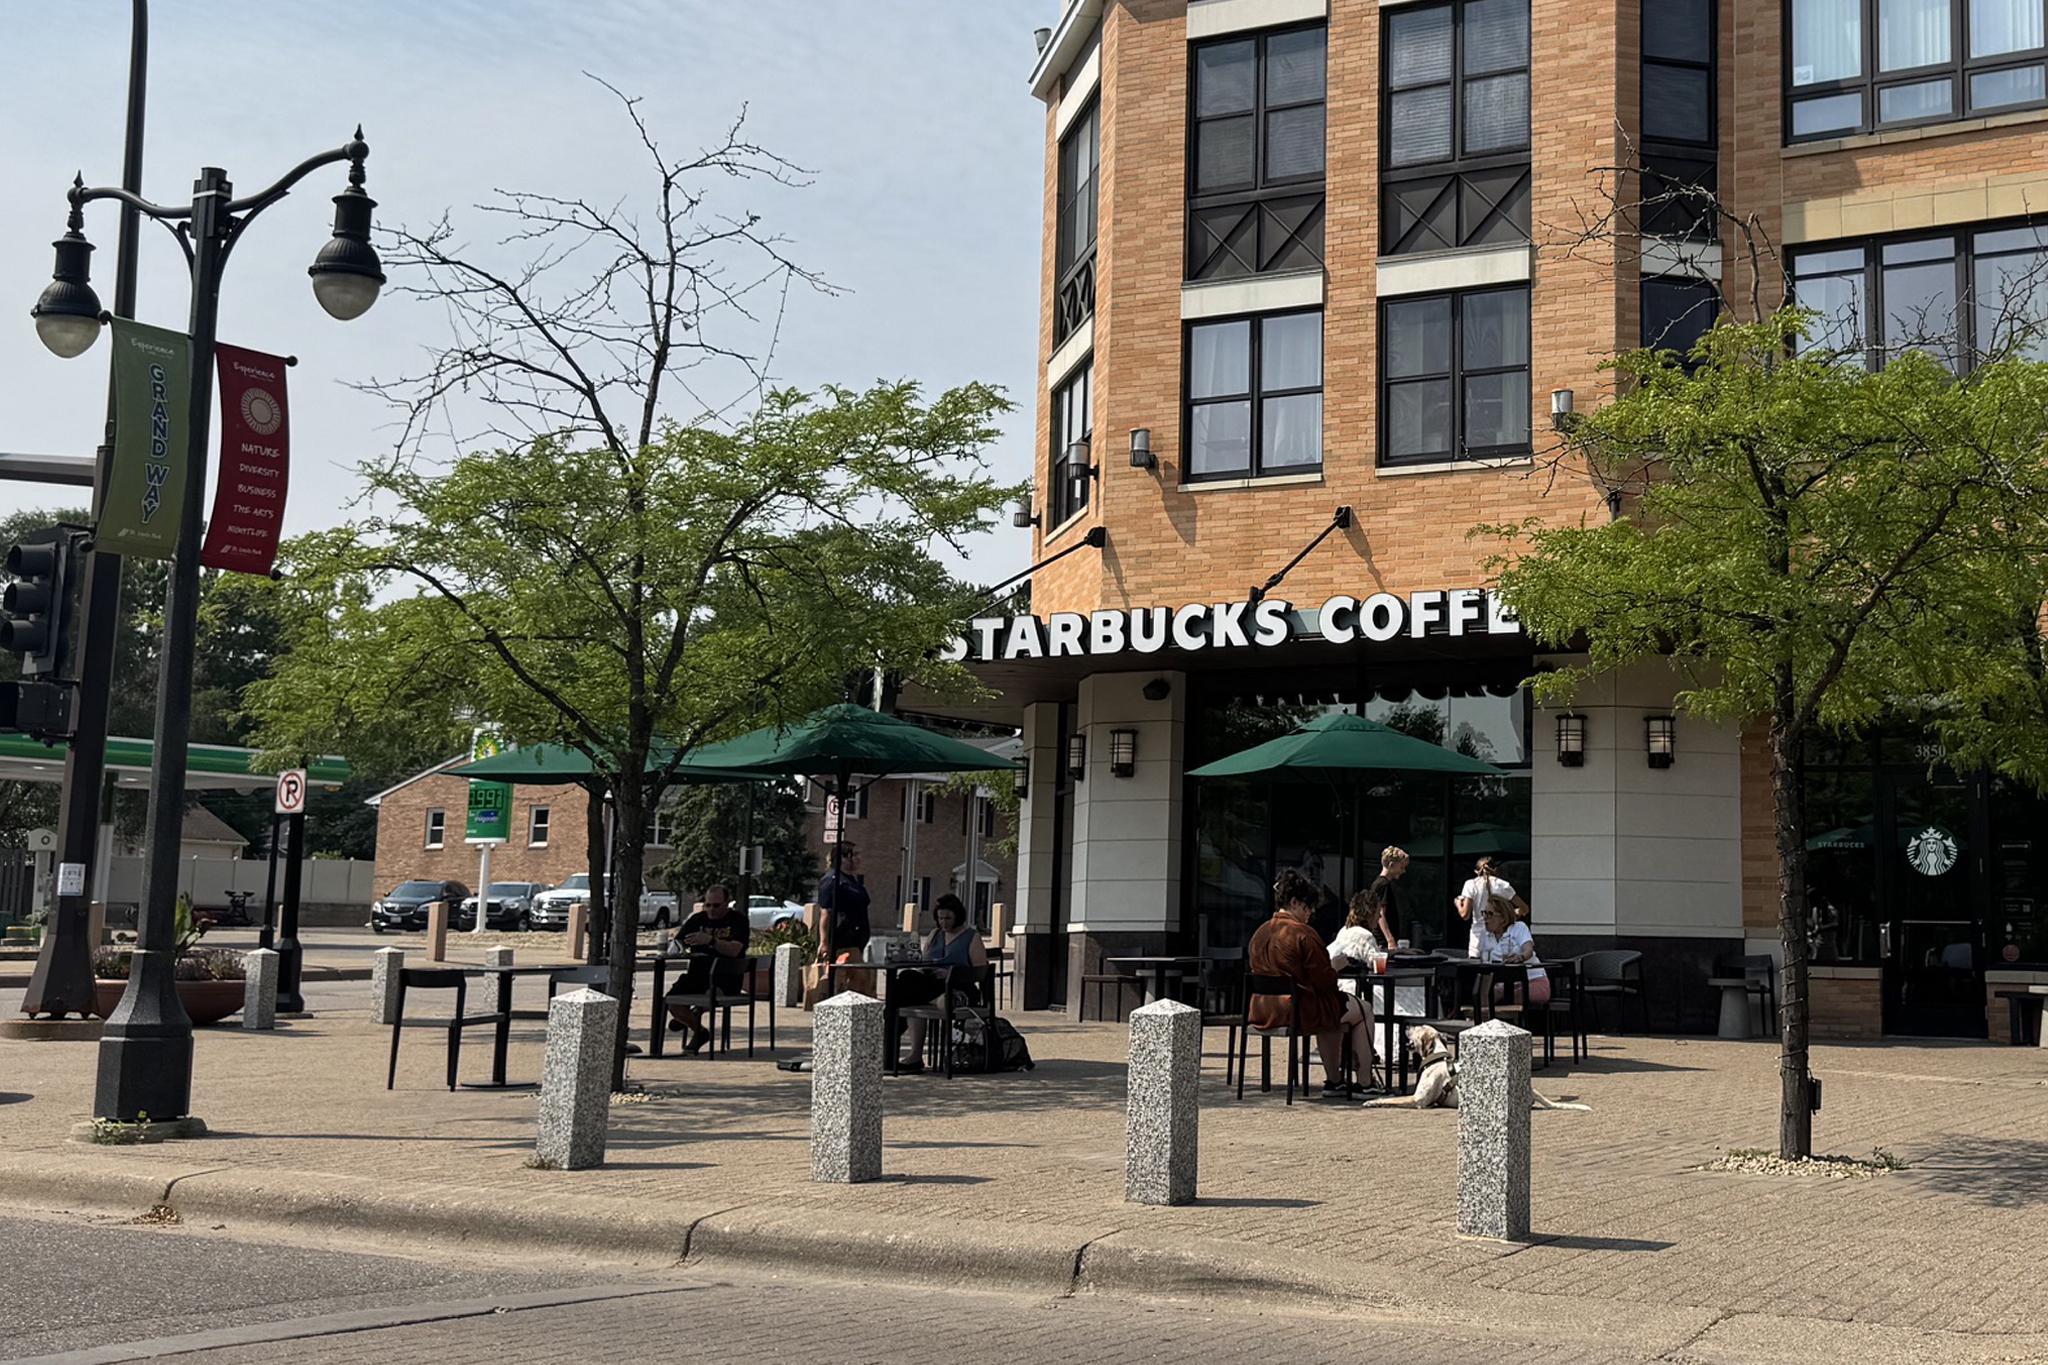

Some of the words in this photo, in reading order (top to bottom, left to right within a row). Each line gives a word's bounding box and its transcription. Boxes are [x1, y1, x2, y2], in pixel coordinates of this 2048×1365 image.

[233, 361, 276, 378] Experience
[149, 363, 169, 458] GRAND
[241, 443, 280, 458] NATURE
[240, 463, 280, 478] DIVERSITY
[142, 463, 170, 524] WAY
[237, 484, 277, 498] BUSINESS
[233, 504, 251, 514] THE
[253, 508, 274, 518] ARTS
[227, 525, 268, 537] NIGHTLIFE
[1319, 587, 1521, 645] COFFE
[1914, 744, 1946, 759] 3850
[1817, 841, 1865, 849] STARBUCKS
